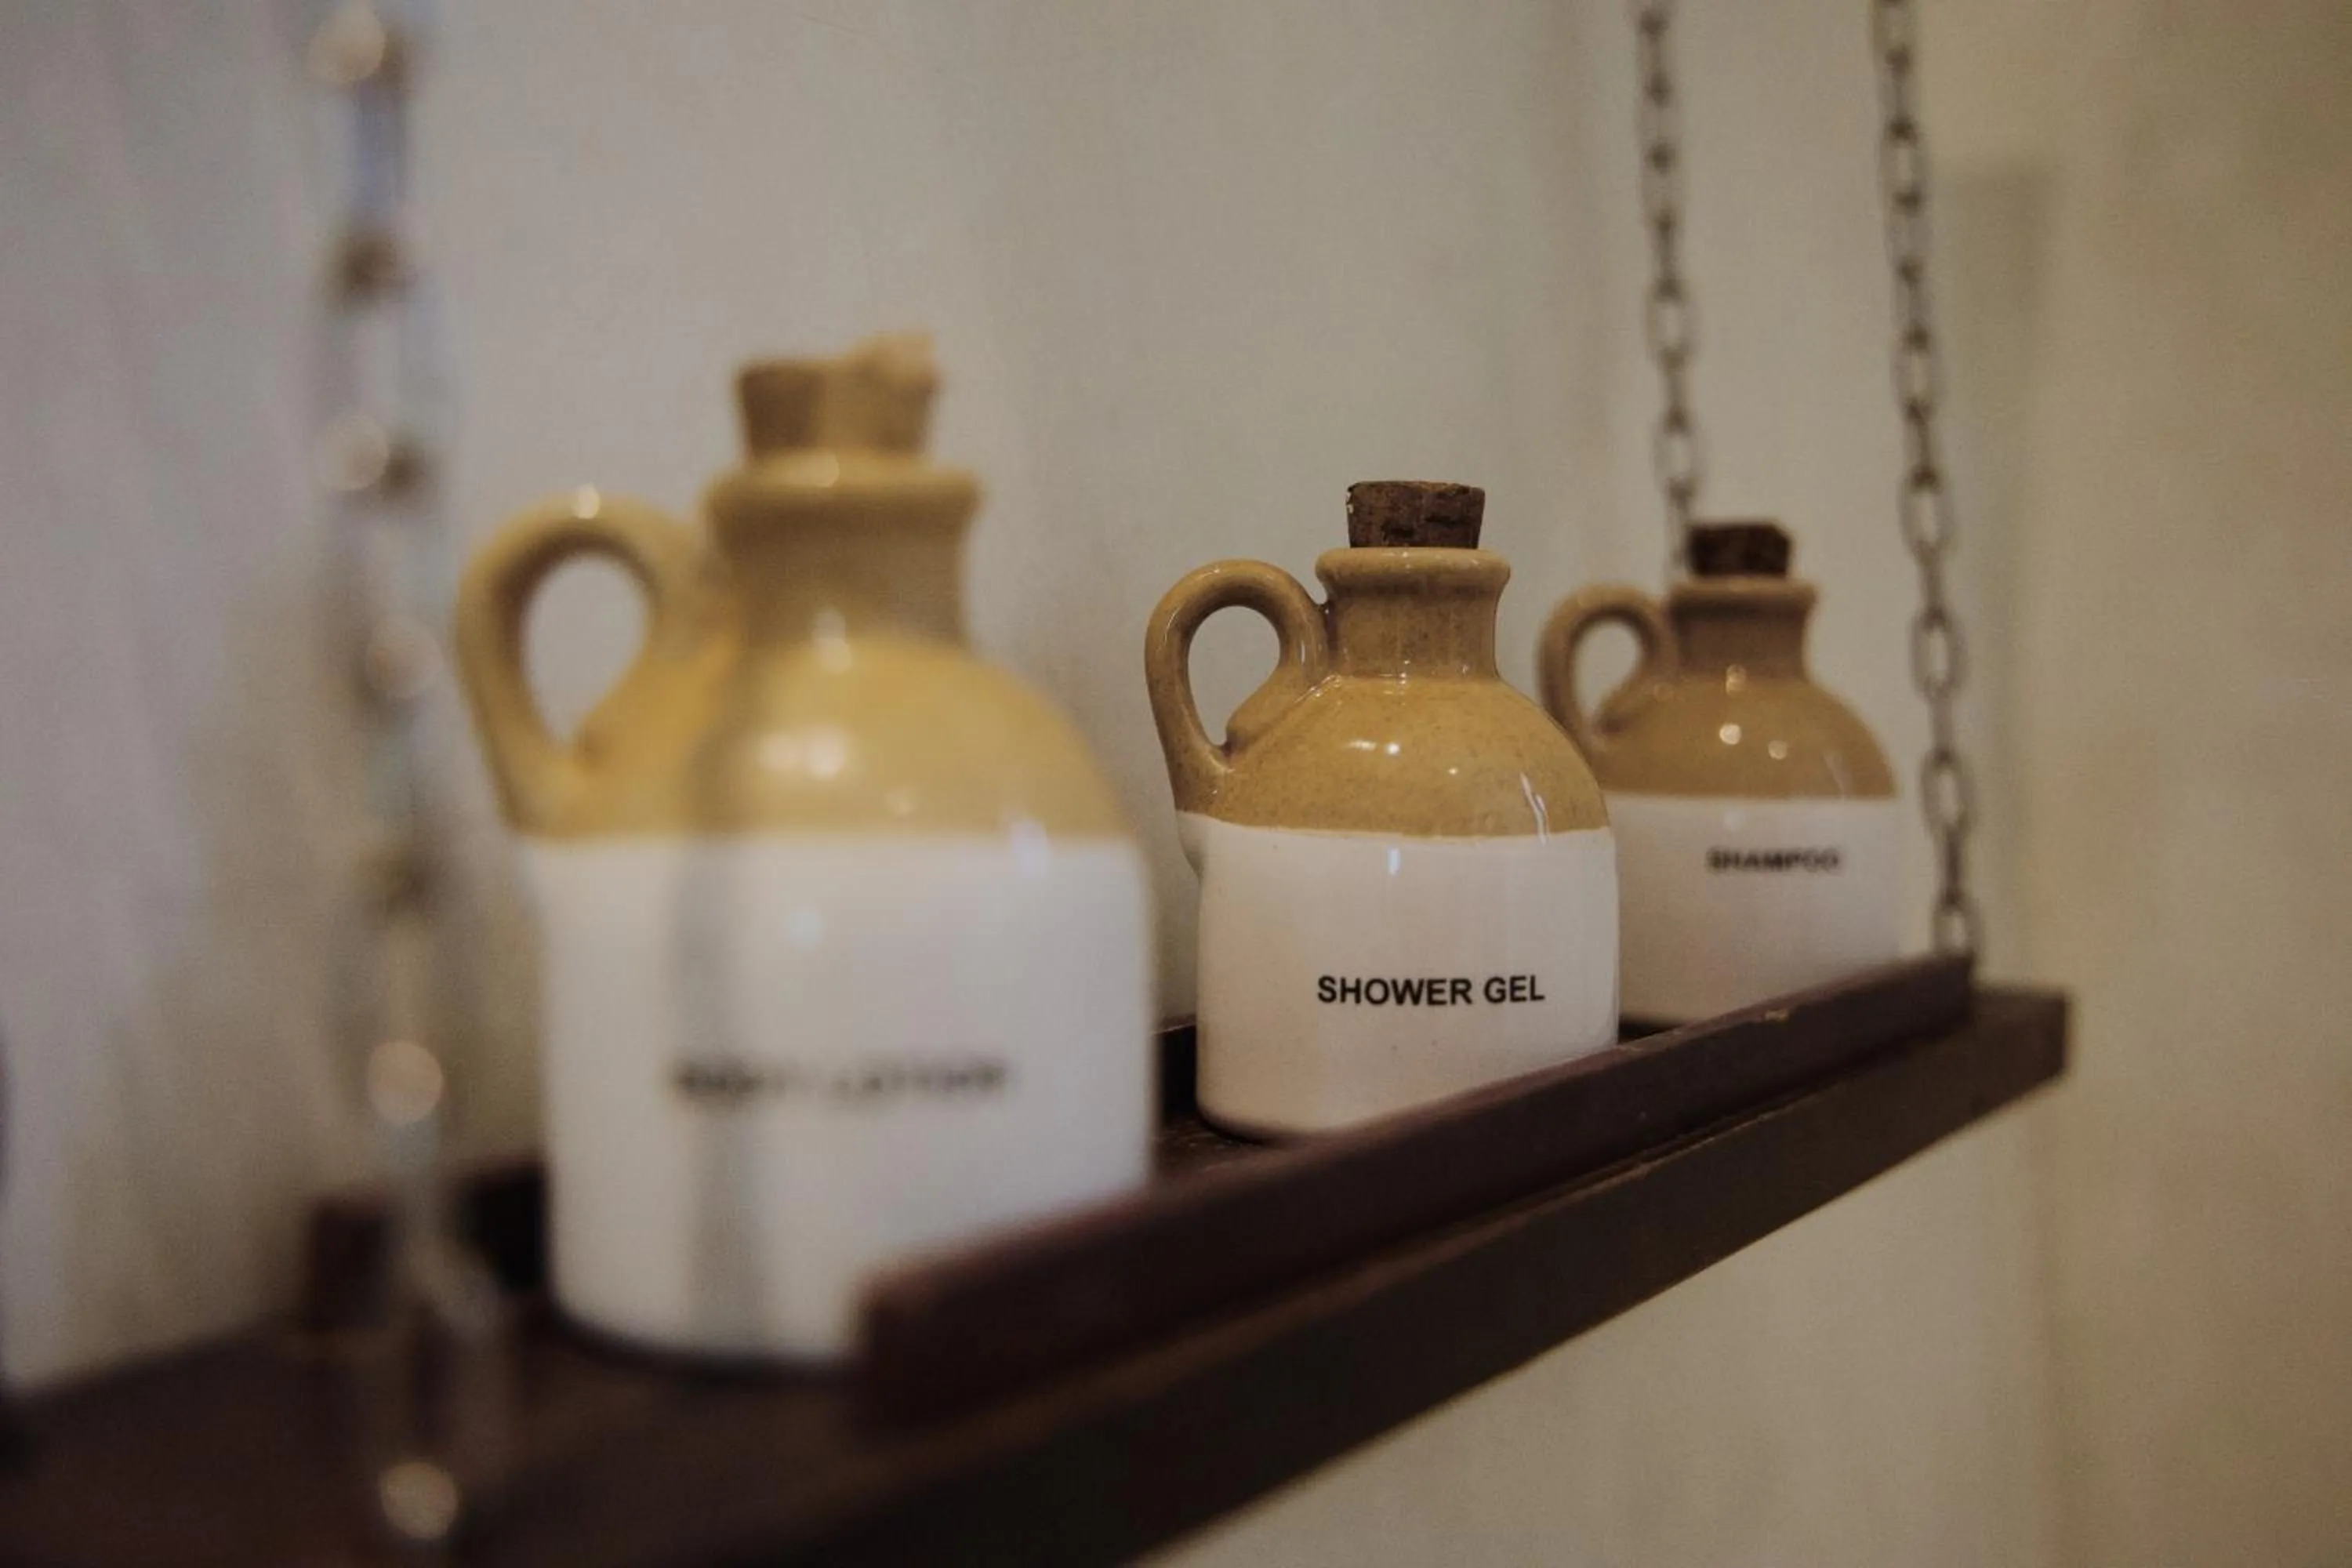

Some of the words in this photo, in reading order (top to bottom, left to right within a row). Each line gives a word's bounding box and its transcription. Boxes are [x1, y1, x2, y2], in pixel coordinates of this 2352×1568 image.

[1706, 847, 1840, 874] SHAMPOO
[1317, 975, 1473, 1007] SHOWER
[1483, 975, 1545, 1004] GEL
